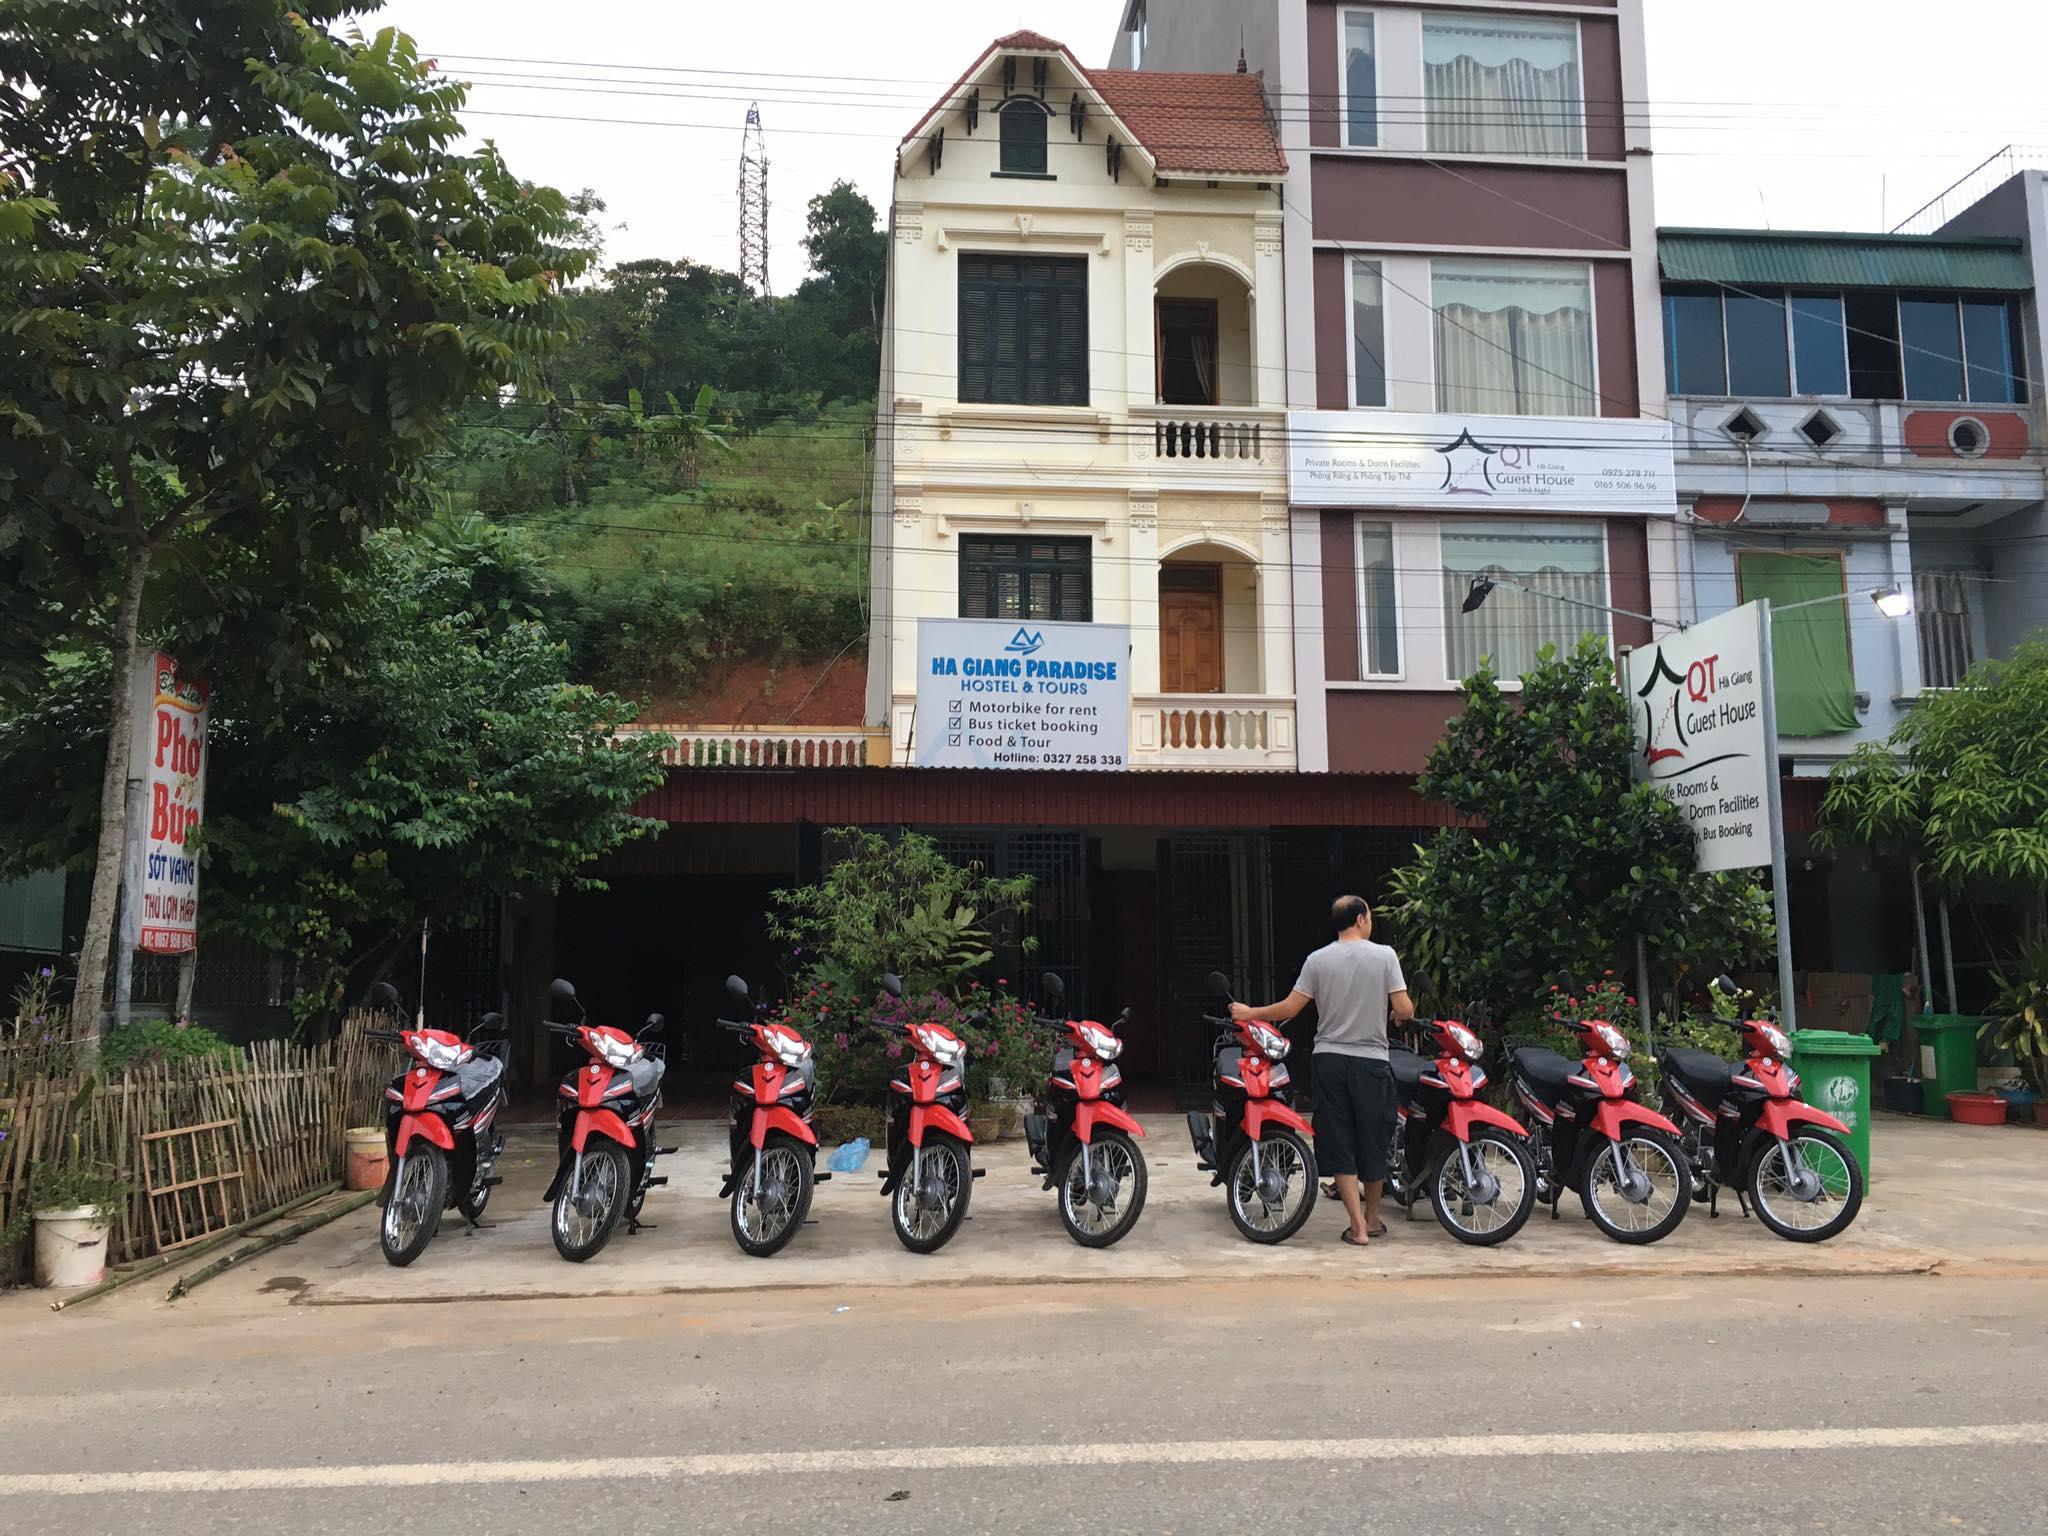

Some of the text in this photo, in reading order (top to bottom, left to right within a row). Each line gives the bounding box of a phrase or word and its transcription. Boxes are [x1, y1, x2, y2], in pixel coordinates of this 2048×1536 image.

[1305, 457, 1421, 469] Private Rooms & Dorm Facilities
[1500, 444, 1536, 469] QT
[1496, 472, 1575, 486] Guest House
[931, 657, 1117, 681] HA GIANG PARADISE
[961, 680, 1088, 695] HOSTEL & TOURS
[1687, 654, 1753, 703] QT Hà Giang
[969, 701, 1097, 716] Motorbike for rent
[969, 718, 1098, 736] Bus ticket booking
[1687, 709, 1716, 735] Guest
[1720, 701, 1756, 727] House
[155, 710, 203, 778] Phở
[968, 735, 1051, 748] Food & Tour
[994, 752, 1122, 765] Hotline: 0327 258 338
[1677, 780, 1708, 798] Rooms
[1711, 775, 1719, 792] &
[1689, 794, 1759, 820] Dorm Facilities
[1703, 827, 1716, 840] Bus
[1719, 822, 1753, 839] Booking
